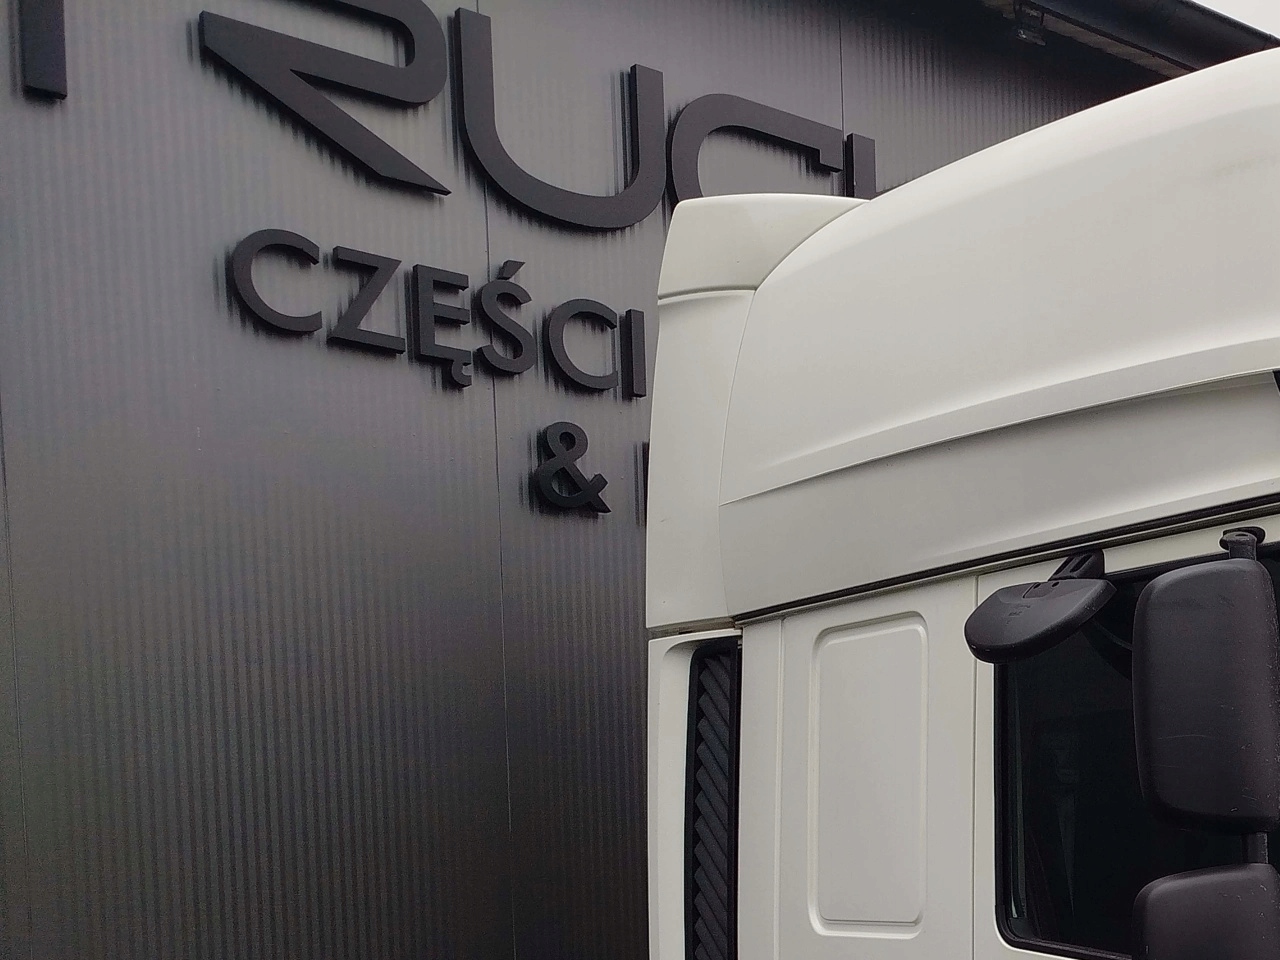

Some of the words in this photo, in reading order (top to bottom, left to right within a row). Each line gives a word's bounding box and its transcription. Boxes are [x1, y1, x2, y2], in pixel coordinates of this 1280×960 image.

[18, 0, 877, 228] RUC
[230, 228, 647, 398] CZĘŚCI
[536, 421, 610, 514] &
